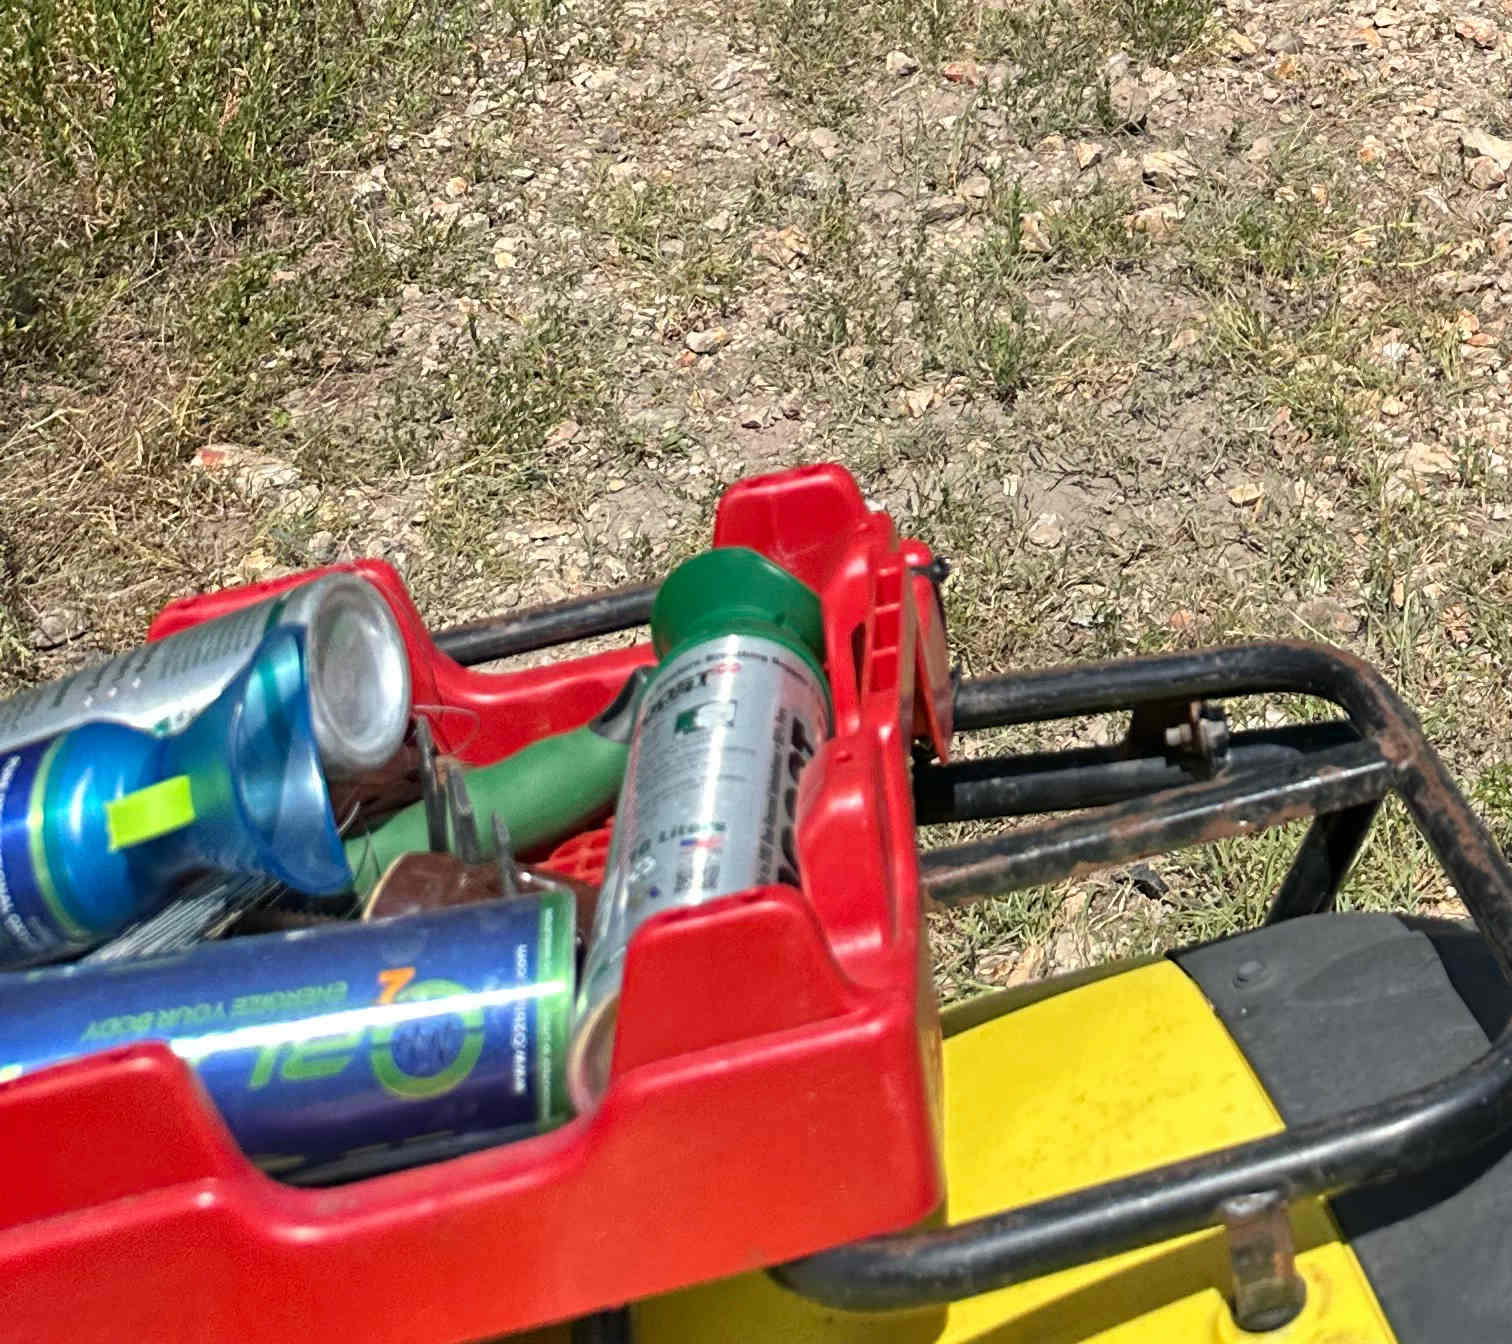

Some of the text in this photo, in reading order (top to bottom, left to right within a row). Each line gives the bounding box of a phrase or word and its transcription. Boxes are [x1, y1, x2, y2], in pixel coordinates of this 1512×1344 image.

[79, 980, 348, 1043] ENERGIZE YOUR BODY
